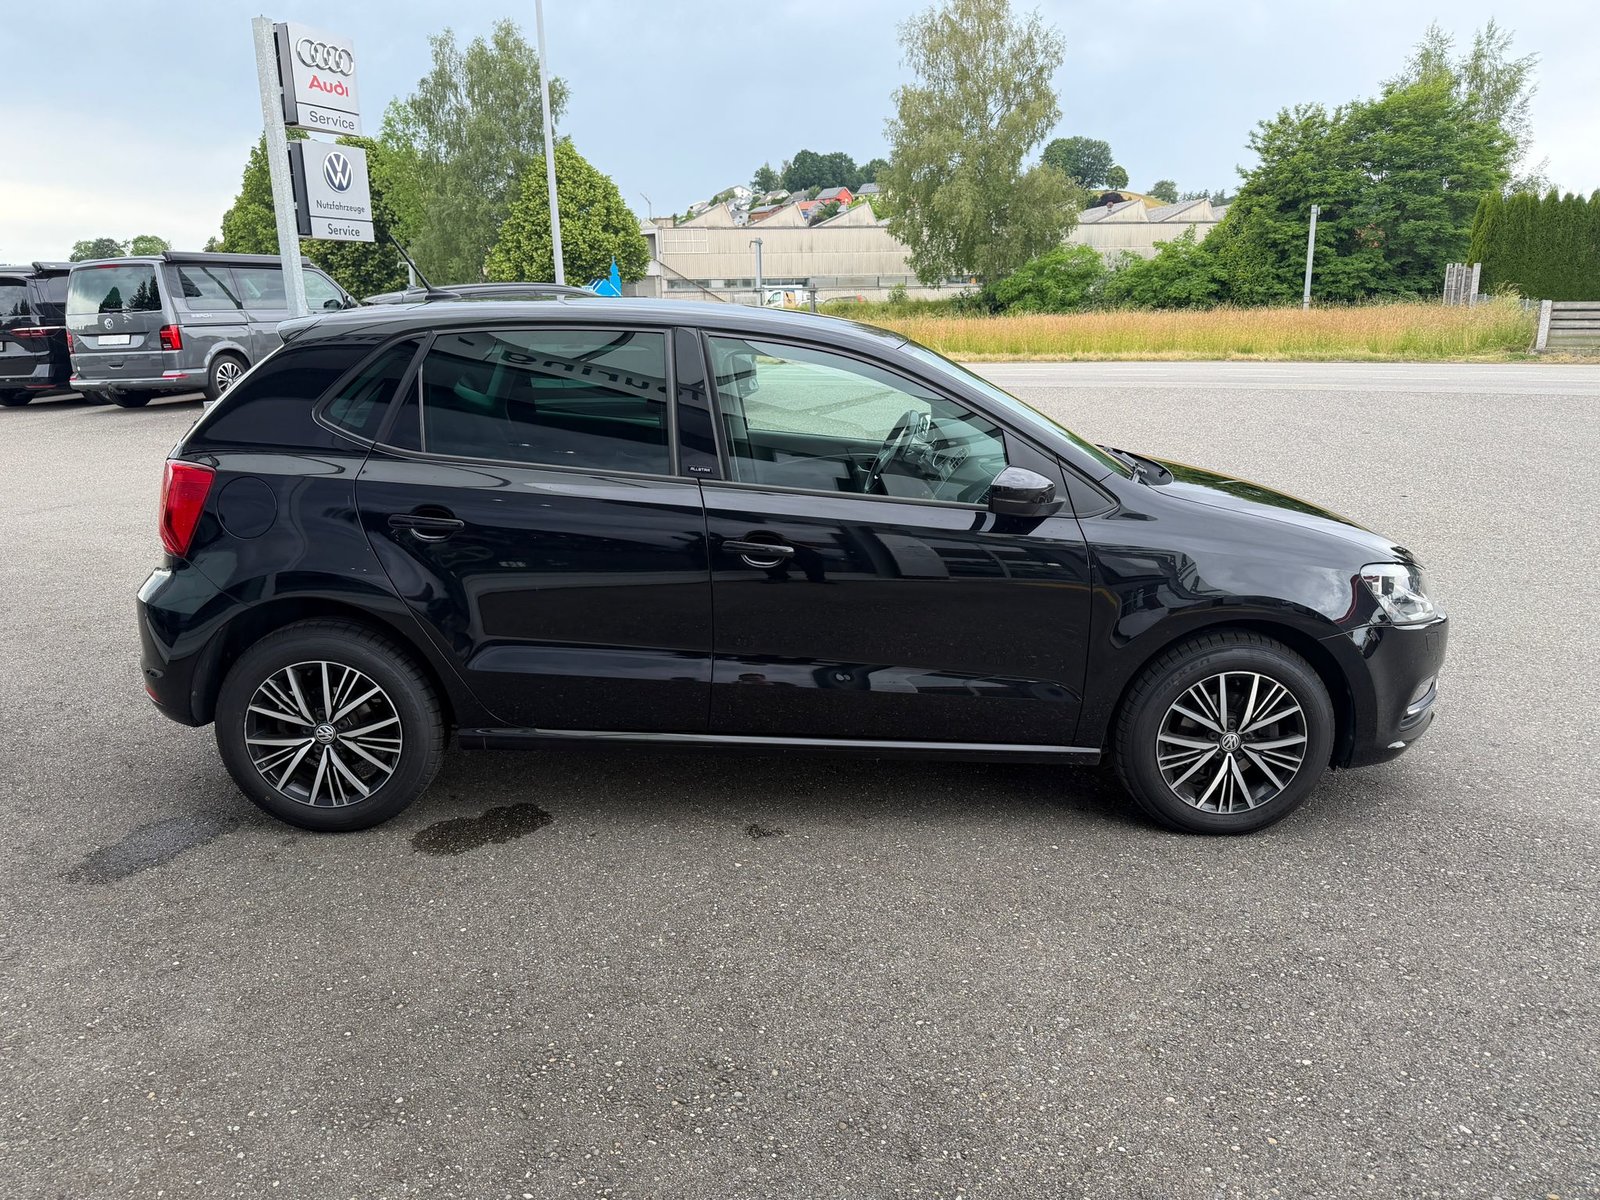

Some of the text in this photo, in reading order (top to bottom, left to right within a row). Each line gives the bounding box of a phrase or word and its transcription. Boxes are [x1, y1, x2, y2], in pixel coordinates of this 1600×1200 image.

[308, 75, 349, 97] Audi
[309, 110, 355, 131] Service
[316, 199, 365, 214] Nutzfahrzeuge
[327, 223, 360, 237] Service
